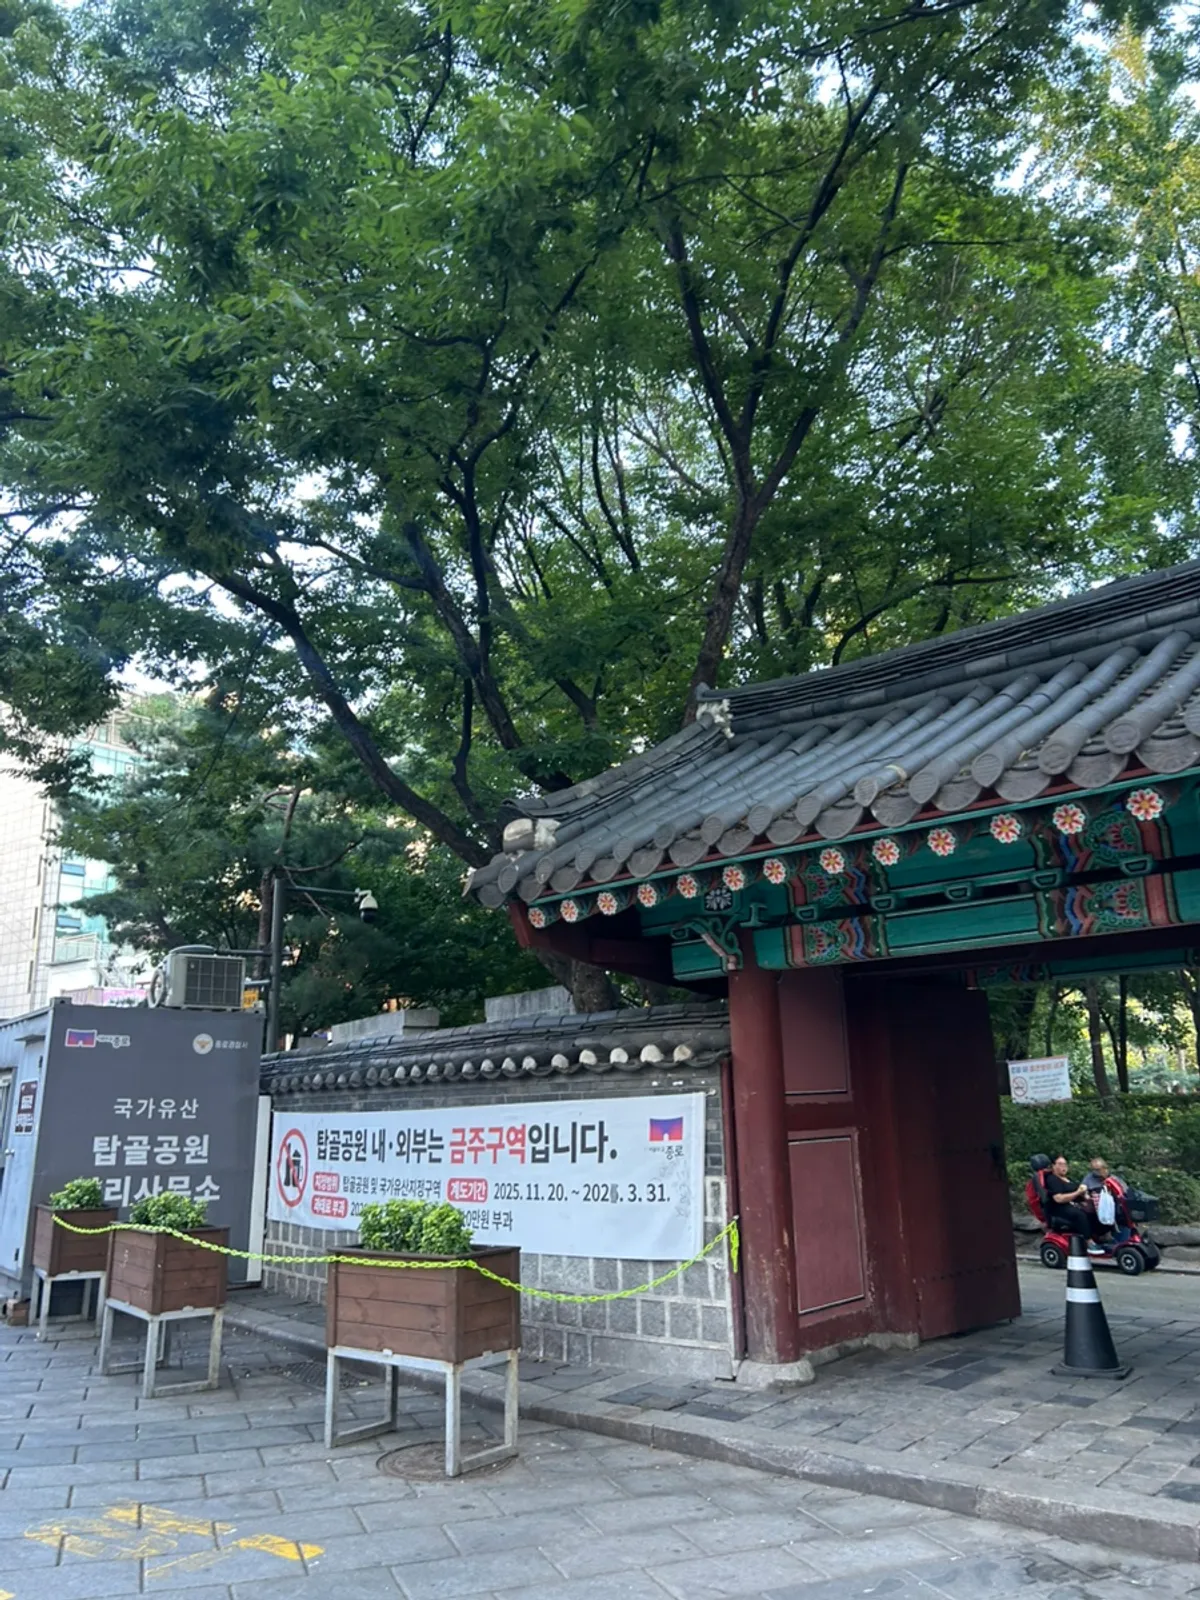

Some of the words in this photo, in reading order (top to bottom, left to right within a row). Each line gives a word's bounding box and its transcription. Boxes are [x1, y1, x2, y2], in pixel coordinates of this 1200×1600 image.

[113, 1097, 200, 1120] 국가유산
[93, 1134, 210, 1167] 탑골공원
[316, 1129, 368, 1163] 탑골공원
[449, 1120, 618, 1165] 금주구역입니다.
[93, 1175, 221, 1208] 리사무소
[342, 1175, 370, 1194] 탑골공원
[371, 1176, 378, 1195] 및
[449, 1180, 487, 1201] 계도기간
[492, 1209, 513, 1232] 부과
